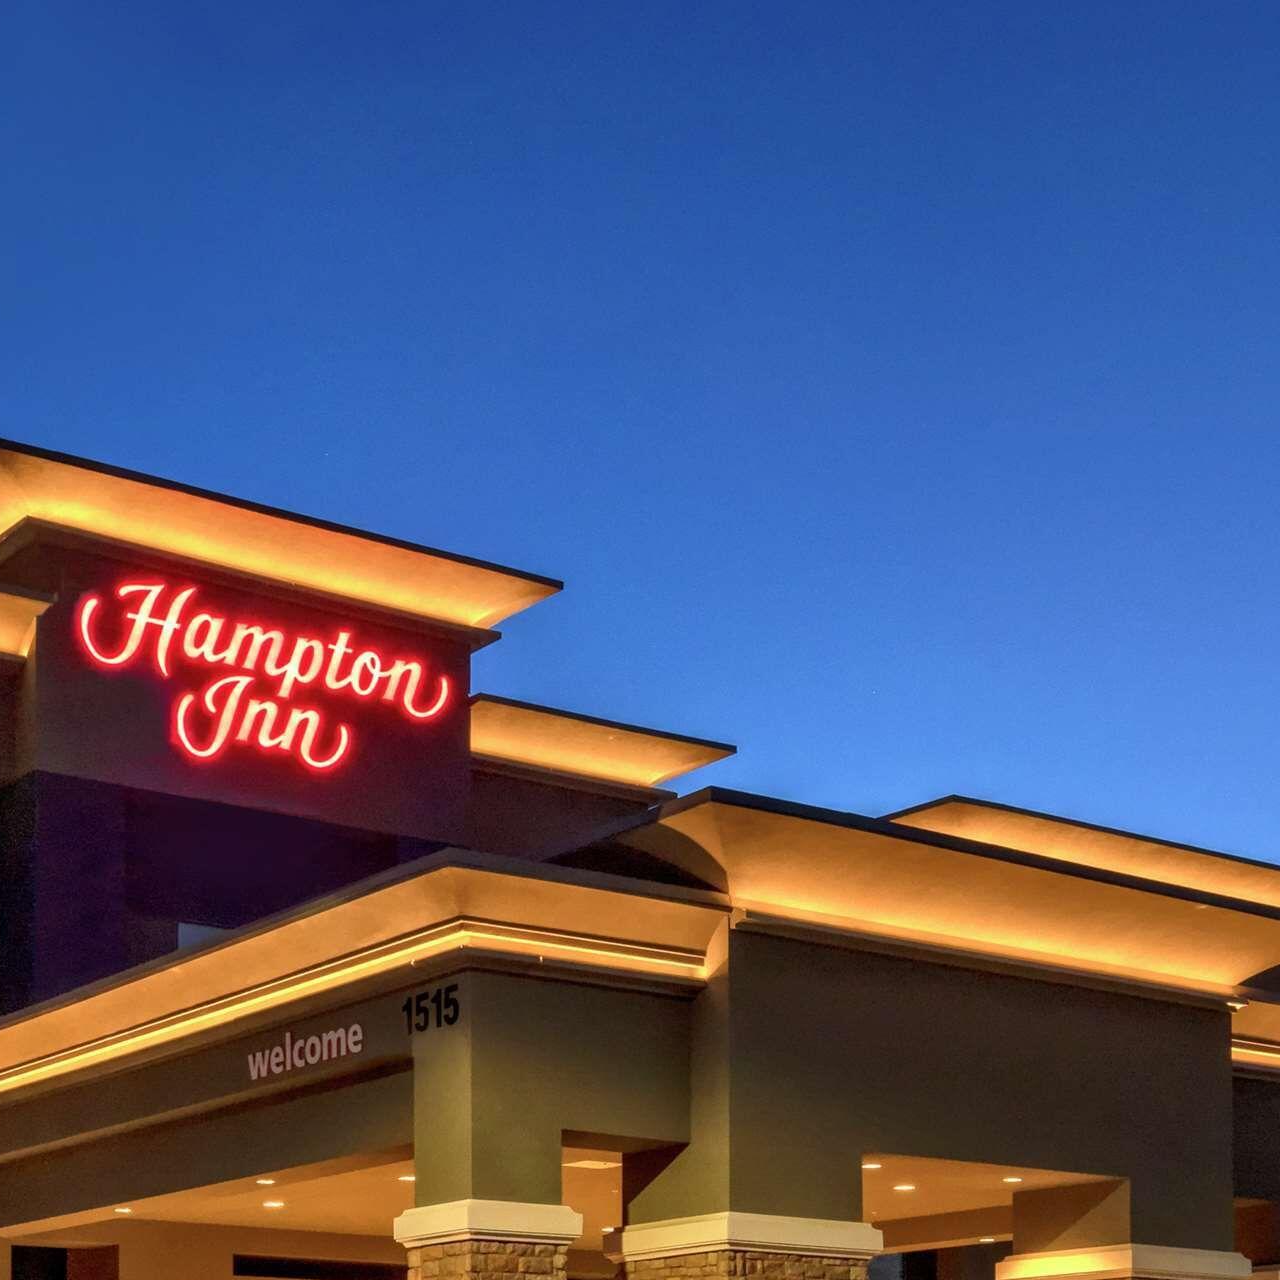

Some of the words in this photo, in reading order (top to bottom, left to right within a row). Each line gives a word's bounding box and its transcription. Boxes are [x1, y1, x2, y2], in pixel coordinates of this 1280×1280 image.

[80, 582, 449, 718] Hampton
[176, 675, 349, 768] Inn
[402, 984, 459, 1036] 1515
[248, 1023, 363, 1080] welcome
